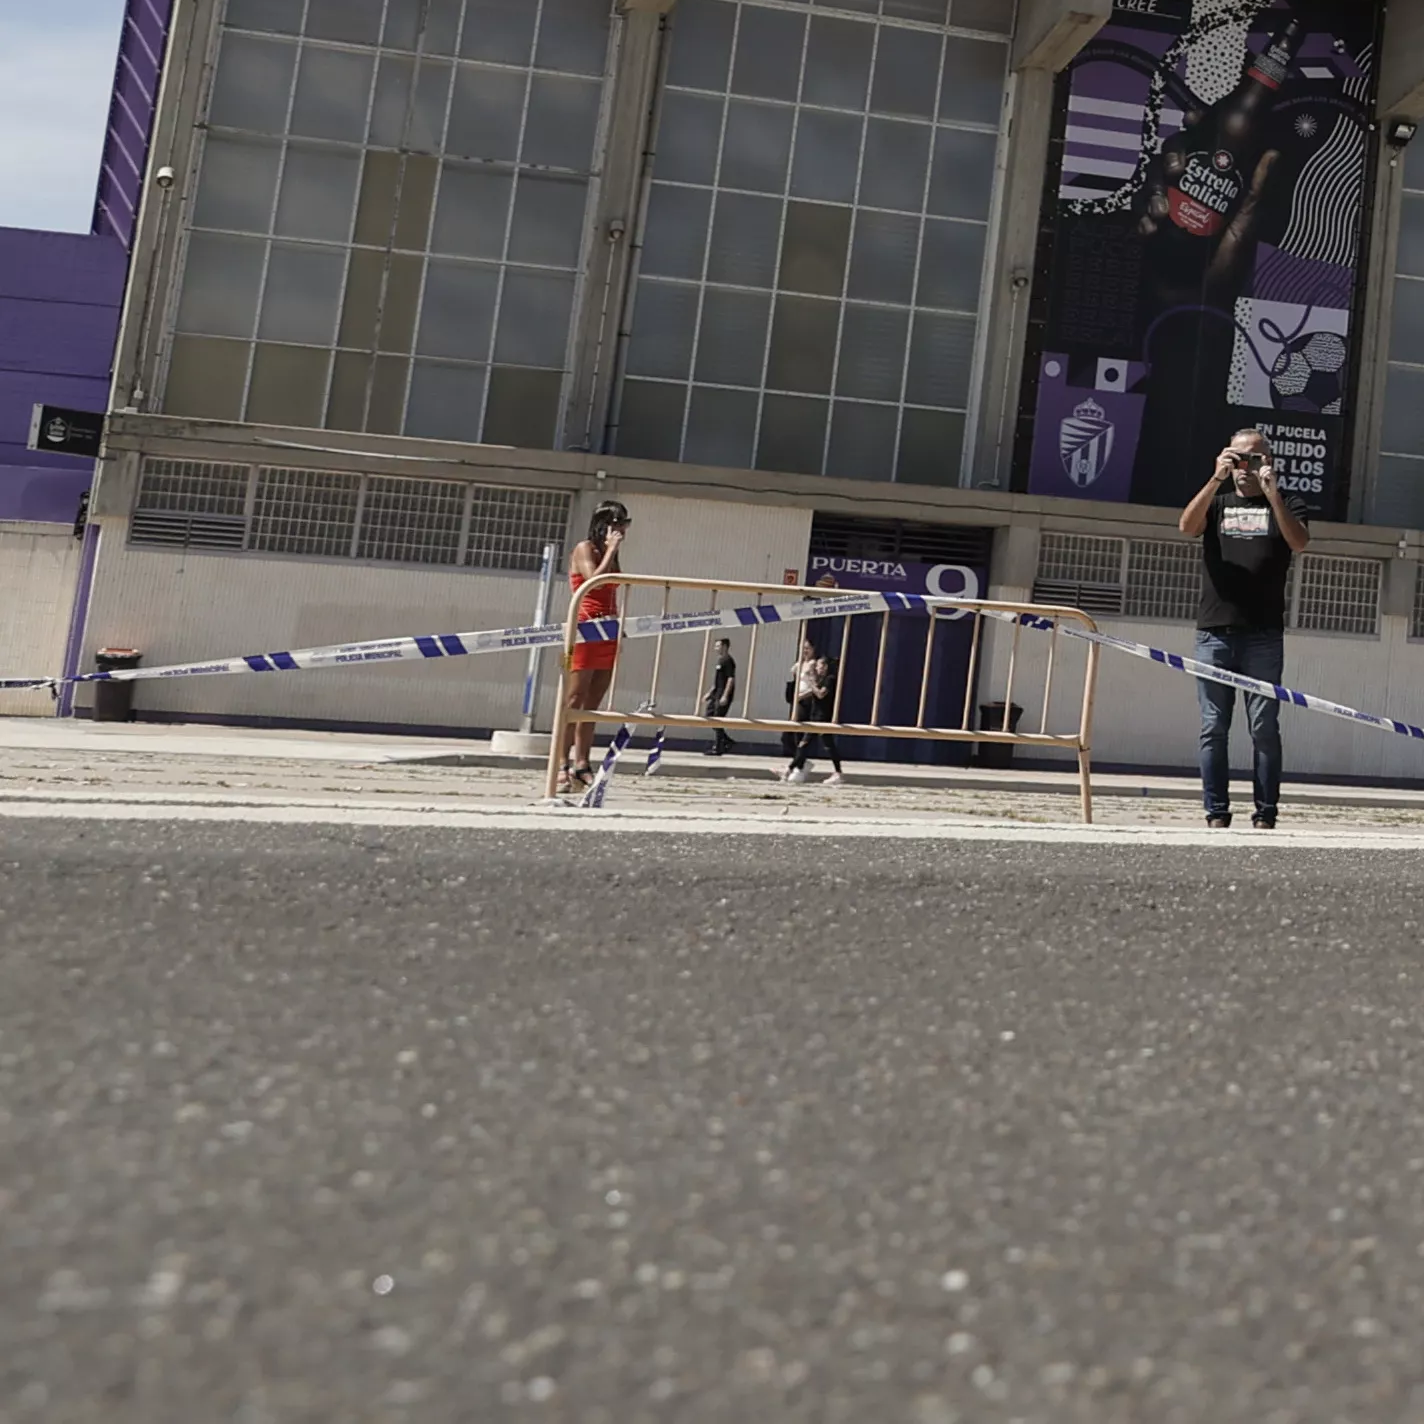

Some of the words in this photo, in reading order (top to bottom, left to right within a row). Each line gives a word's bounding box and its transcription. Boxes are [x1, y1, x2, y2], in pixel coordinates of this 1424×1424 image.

[1185, 158, 1239, 199] Estrella
[1178, 174, 1229, 213] Galicia
[1276, 425, 1327, 441] PUCELA
[1269, 439, 1327, 459] HIBIDO
[1290, 459, 1325, 476] LOS
[1276, 475, 1323, 493] AZOS
[812, 556, 907, 577] PUERTA
[925, 564, 979, 620] 9
